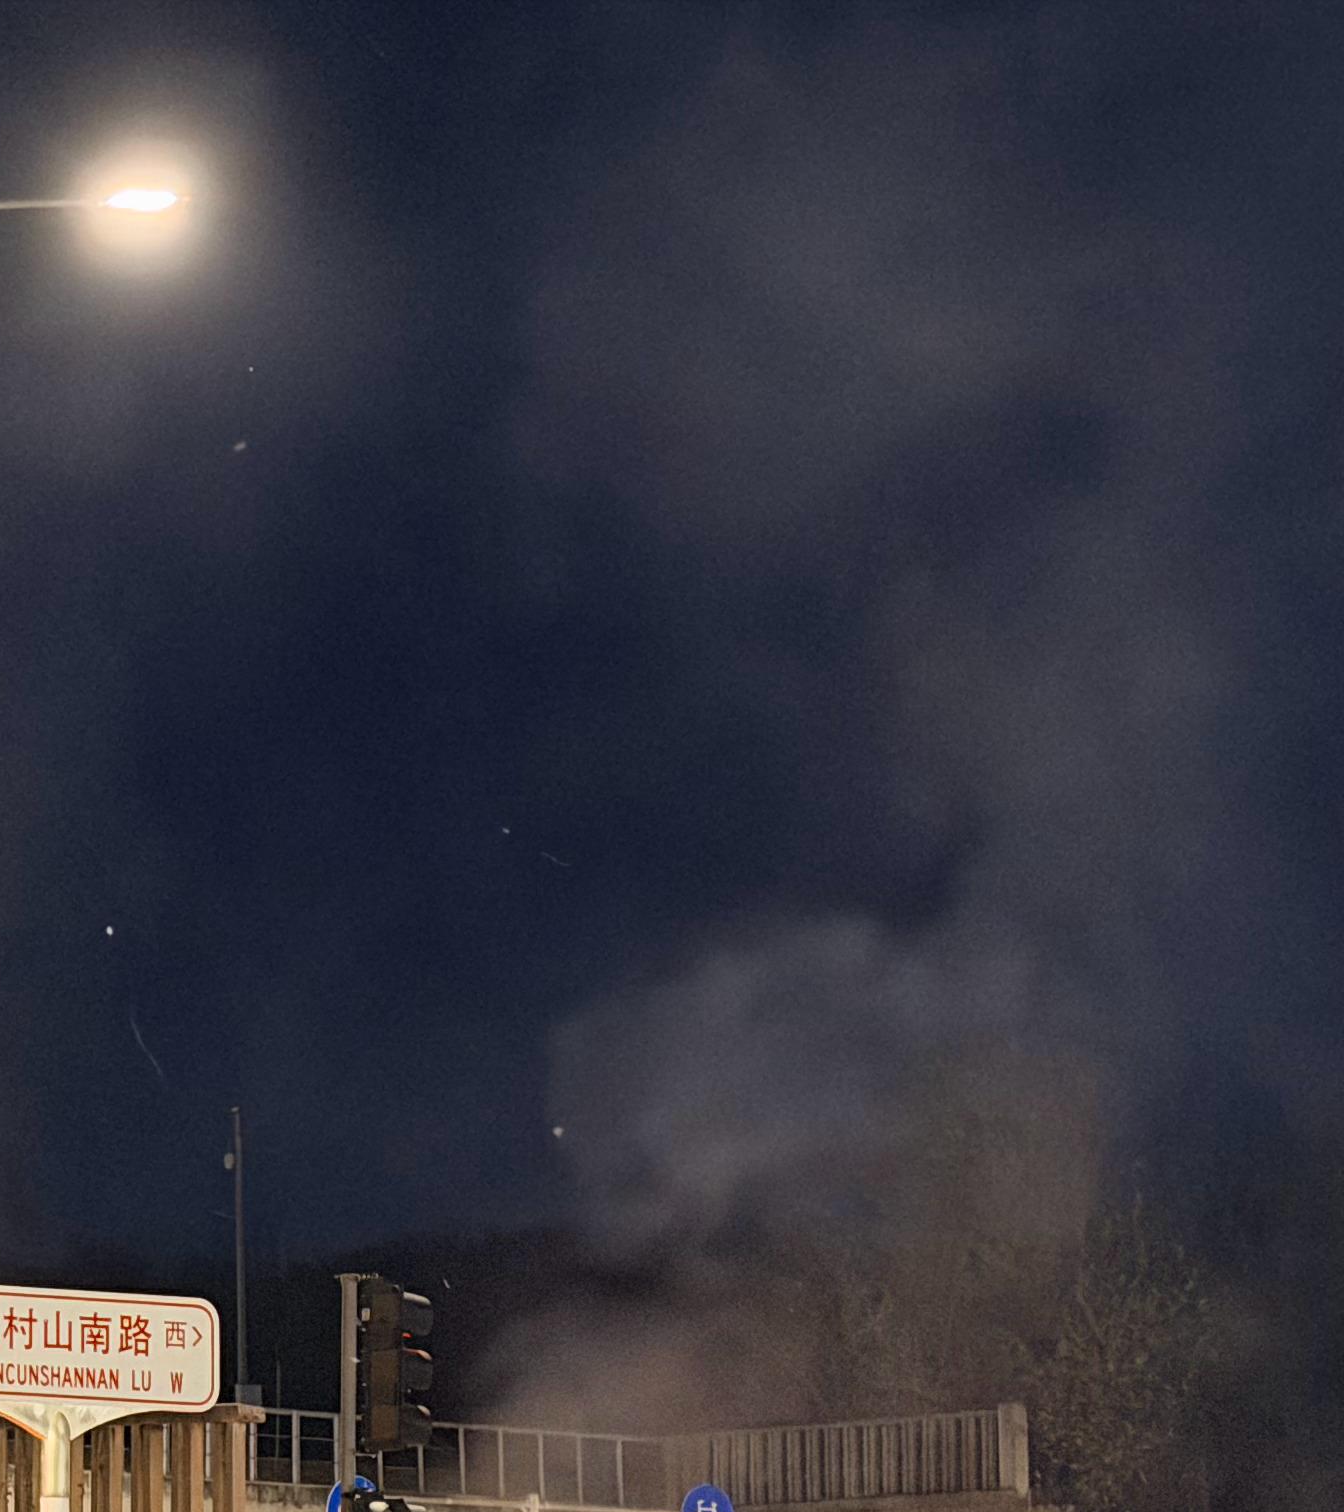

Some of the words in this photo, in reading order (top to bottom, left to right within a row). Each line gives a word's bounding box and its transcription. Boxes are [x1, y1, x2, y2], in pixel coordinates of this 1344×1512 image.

[164, 1320, 187, 1349] 西
[131, 1369, 152, 1392] LU
[170, 1371, 183, 1394] W
